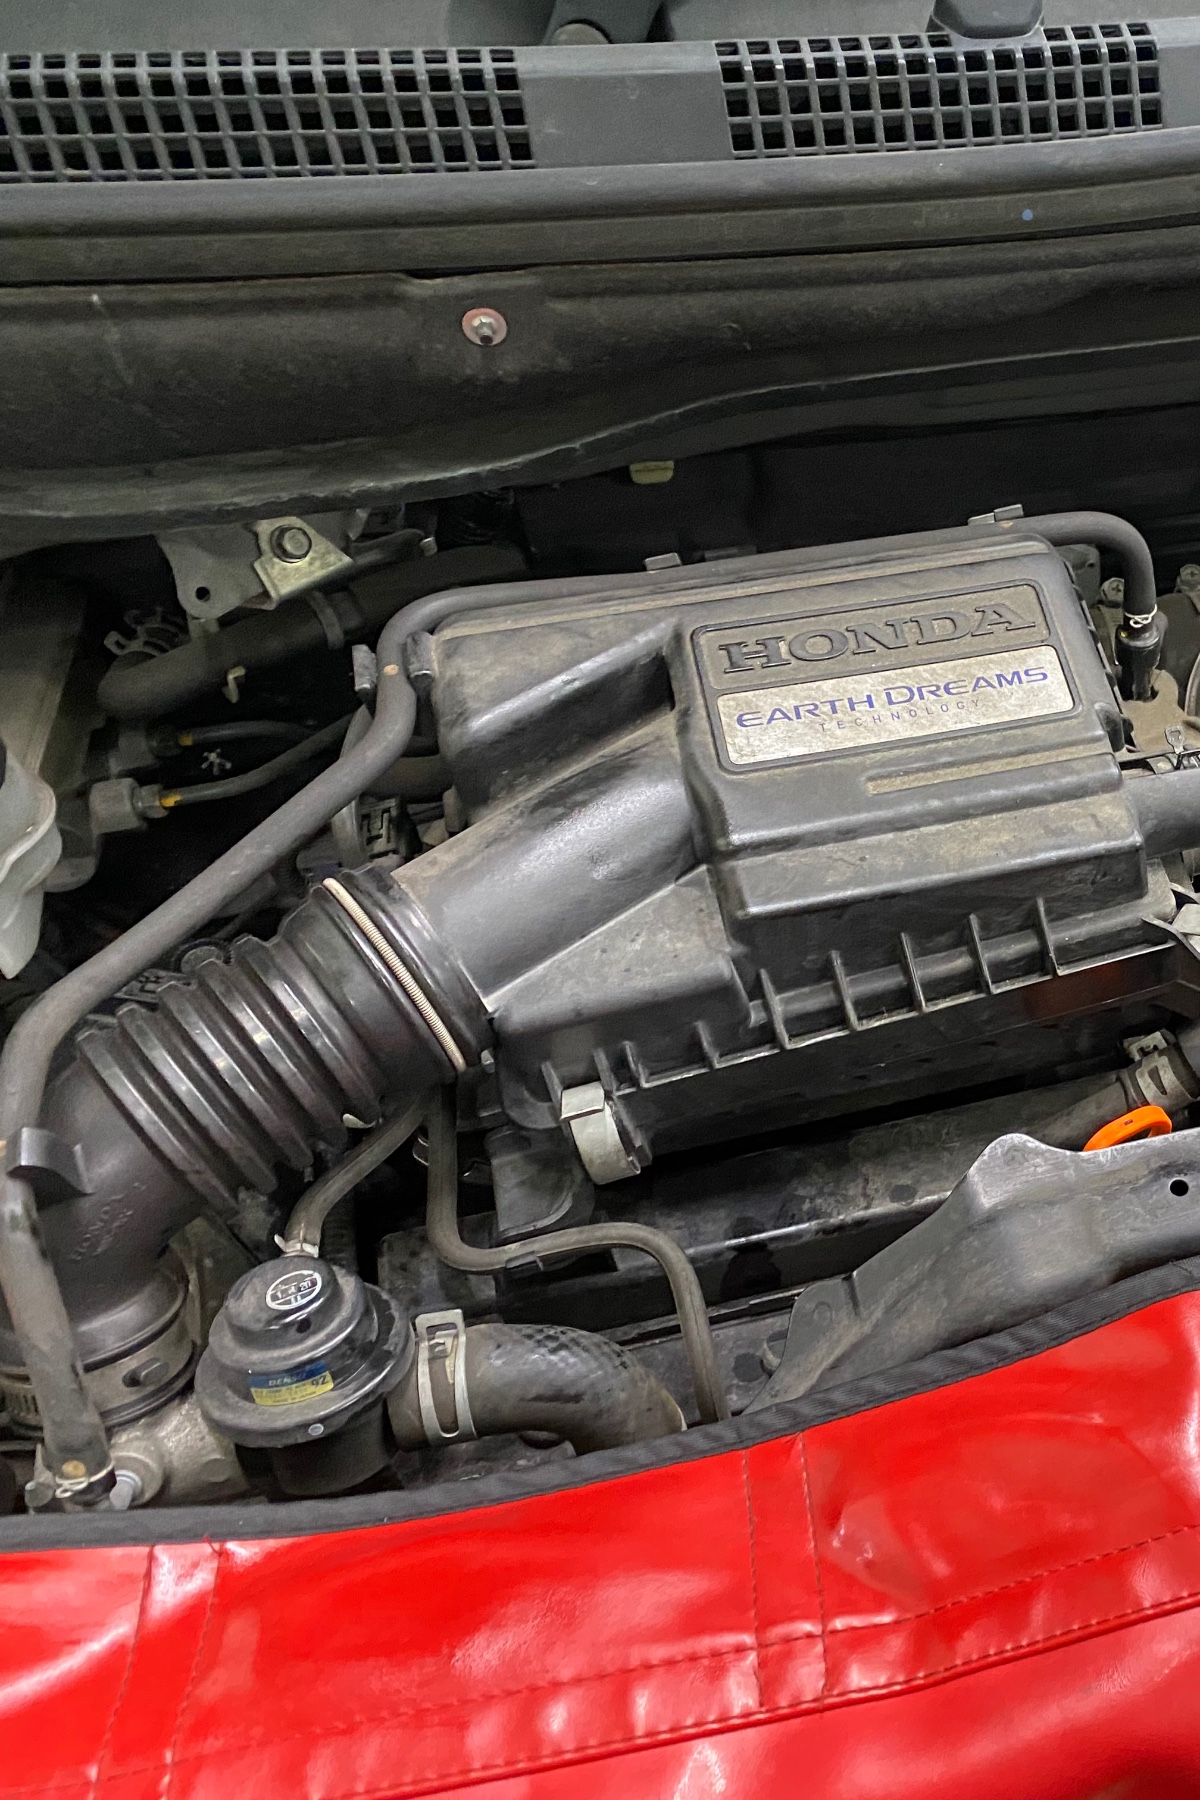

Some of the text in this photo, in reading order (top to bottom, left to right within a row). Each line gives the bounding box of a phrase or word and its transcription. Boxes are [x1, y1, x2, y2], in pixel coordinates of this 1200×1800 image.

[718, 602, 1037, 674] HONDA
[735, 665, 1049, 729] EARTH DREAMS
[818, 698, 982, 733] TECHNOLOGY
